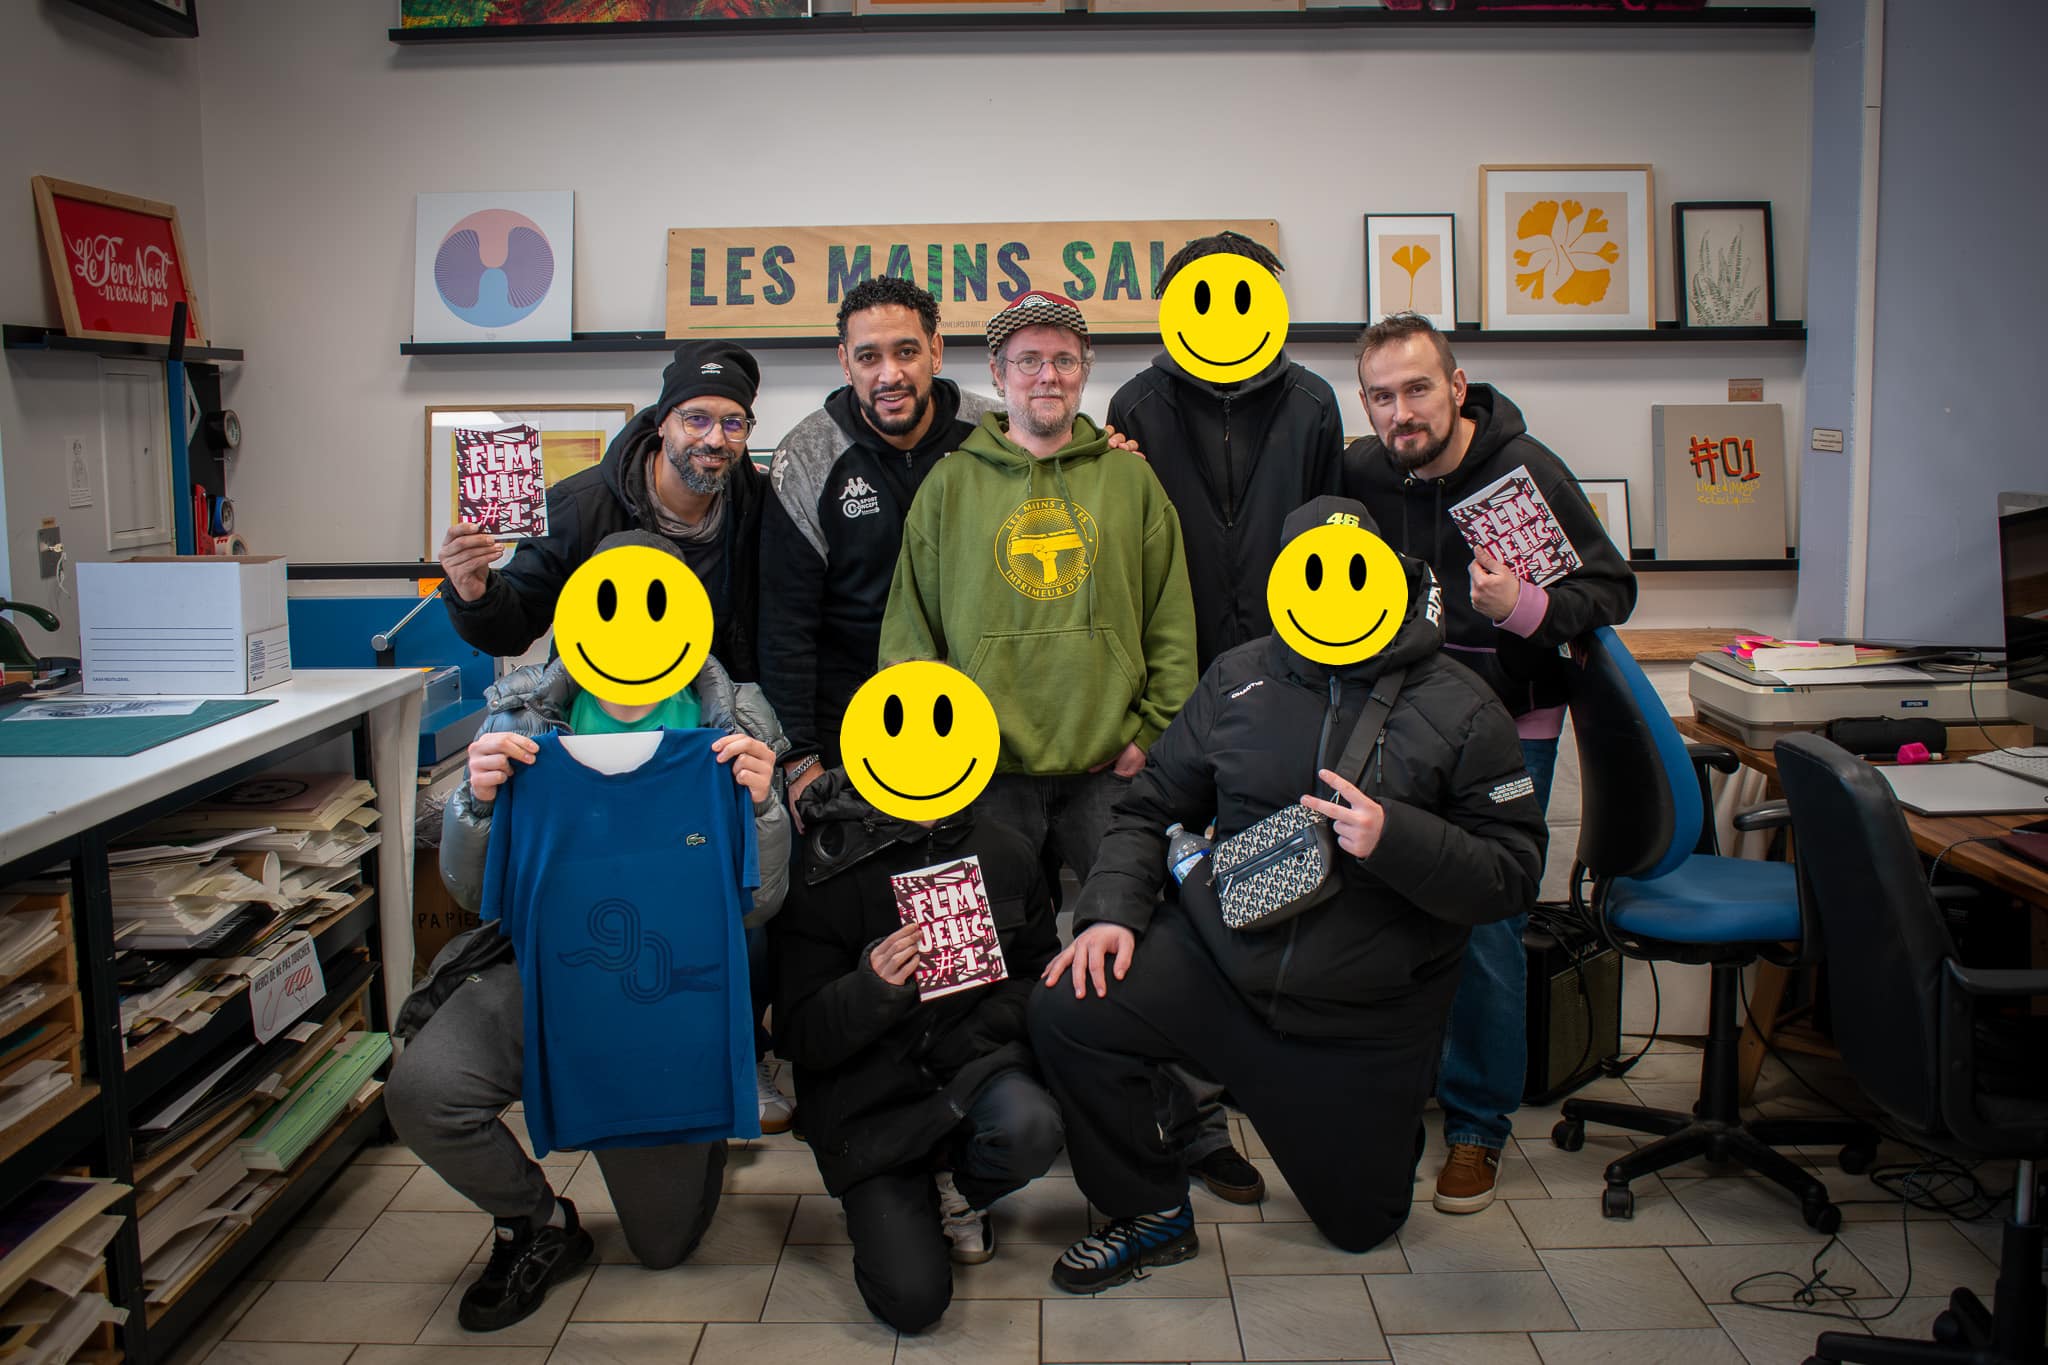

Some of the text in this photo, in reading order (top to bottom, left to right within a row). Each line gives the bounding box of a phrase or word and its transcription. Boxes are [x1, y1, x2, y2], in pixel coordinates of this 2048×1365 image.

[689, 240, 1197, 306] LES MAINS SAL
[98, 283, 168, 312] n'existe pas
[467, 442, 534, 474] FLM
[1688, 434, 1761, 485] #01
[464, 473, 536, 501] UEHC
[481, 501, 522, 527] #1
[1060, 502, 1089, 523] SES
[1470, 492, 1539, 546] FLM
[1005, 568, 1063, 597] IMPRIMEUR
[910, 880, 979, 924] FLM
[933, 946, 979, 979] #1
